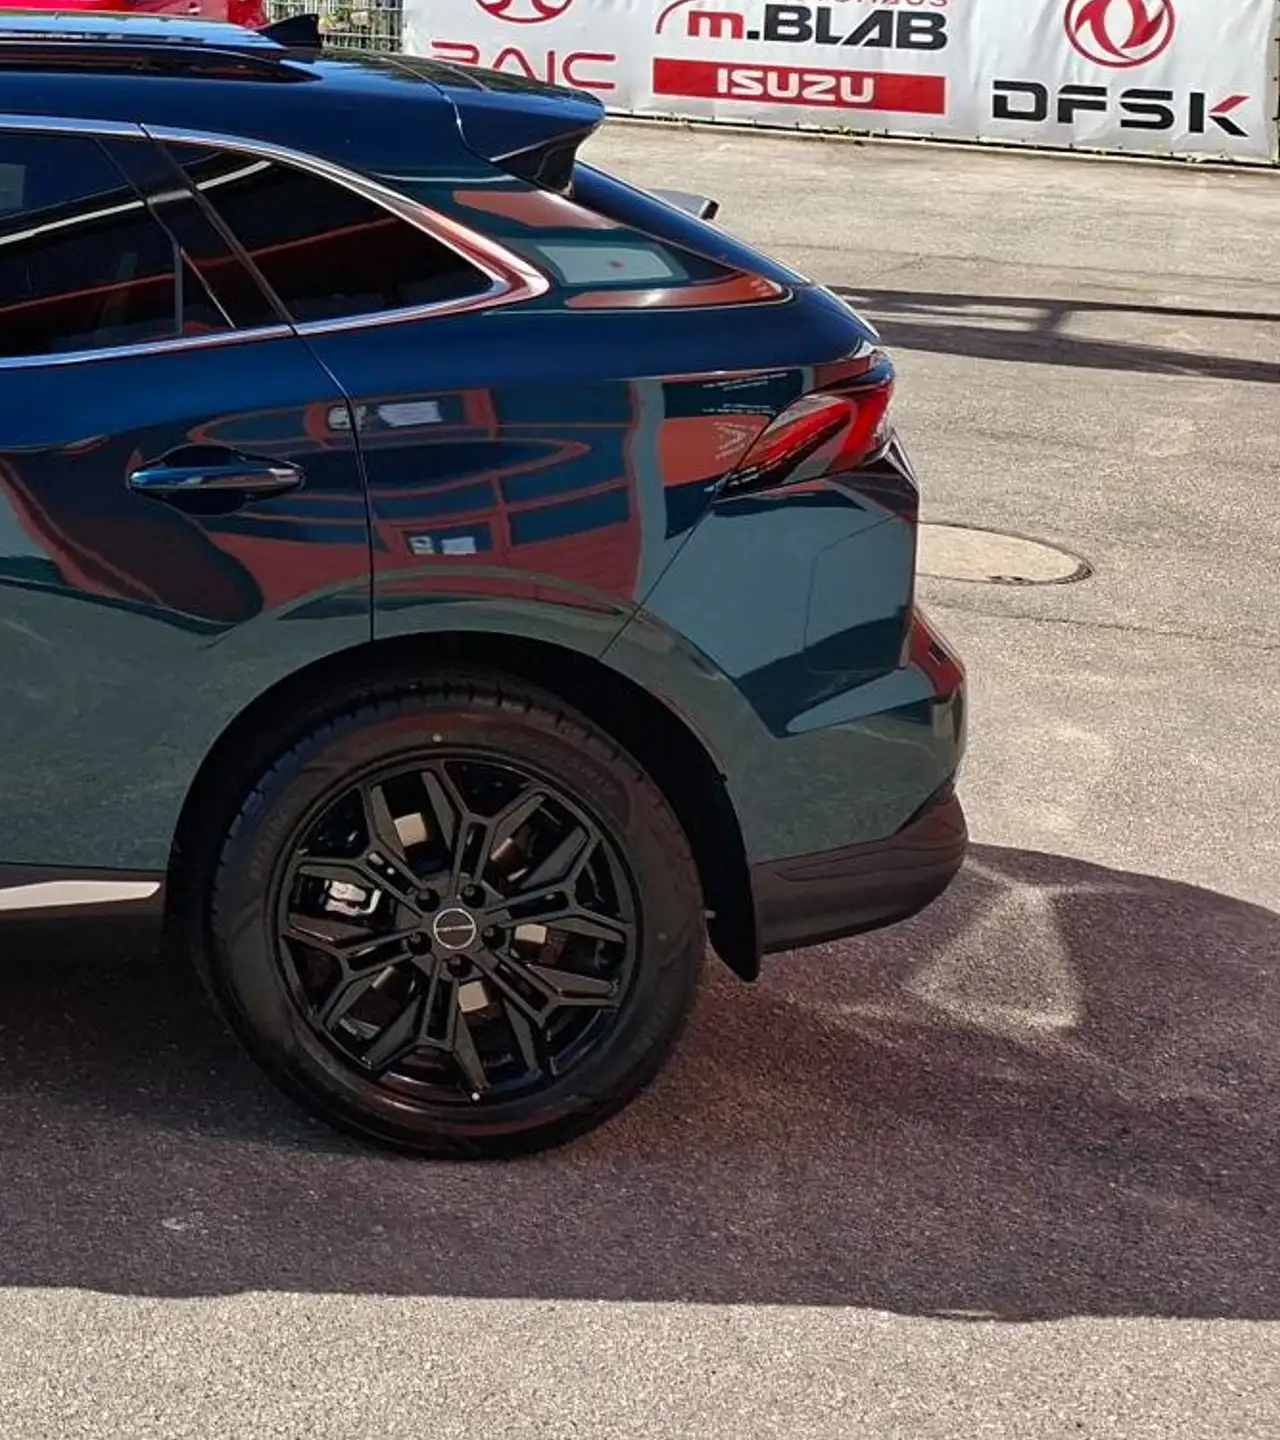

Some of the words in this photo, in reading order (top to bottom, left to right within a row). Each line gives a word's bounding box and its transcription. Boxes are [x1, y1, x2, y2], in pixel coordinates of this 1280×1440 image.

[687, 4, 947, 51] m.BLAB
[717, 68, 875, 103] ISUZU
[993, 80, 1251, 137] DFSK
